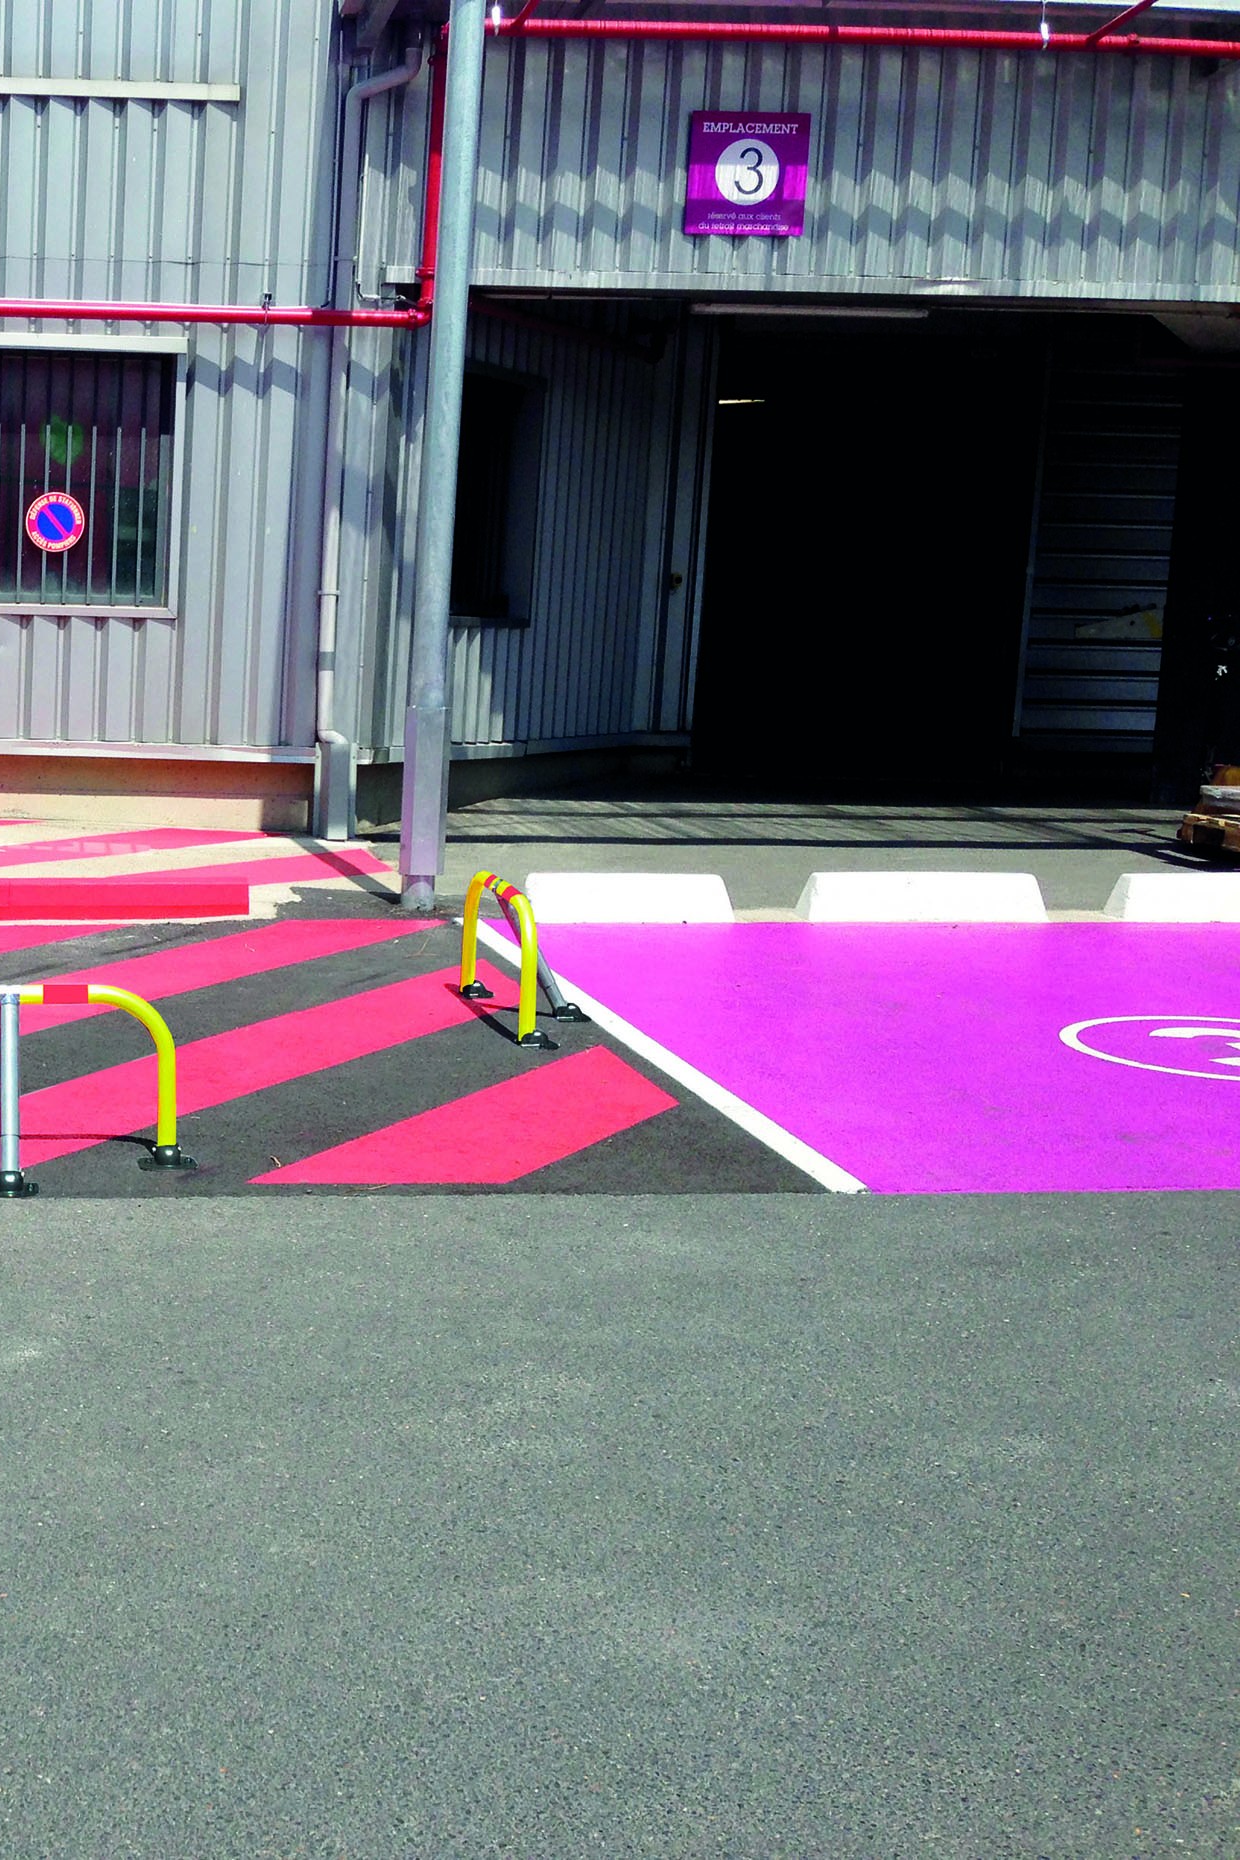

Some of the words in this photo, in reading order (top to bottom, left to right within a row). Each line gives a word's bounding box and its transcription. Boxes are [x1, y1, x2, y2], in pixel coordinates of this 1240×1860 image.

[702, 122, 799, 135] EMPLACEMENT
[734, 147, 764, 195] 3
[738, 213, 754, 221] aux
[755, 213, 782, 221] clients
[698, 221, 710, 230] du
[711, 222, 735, 231] retrait
[736, 222, 789, 232] marchandise
